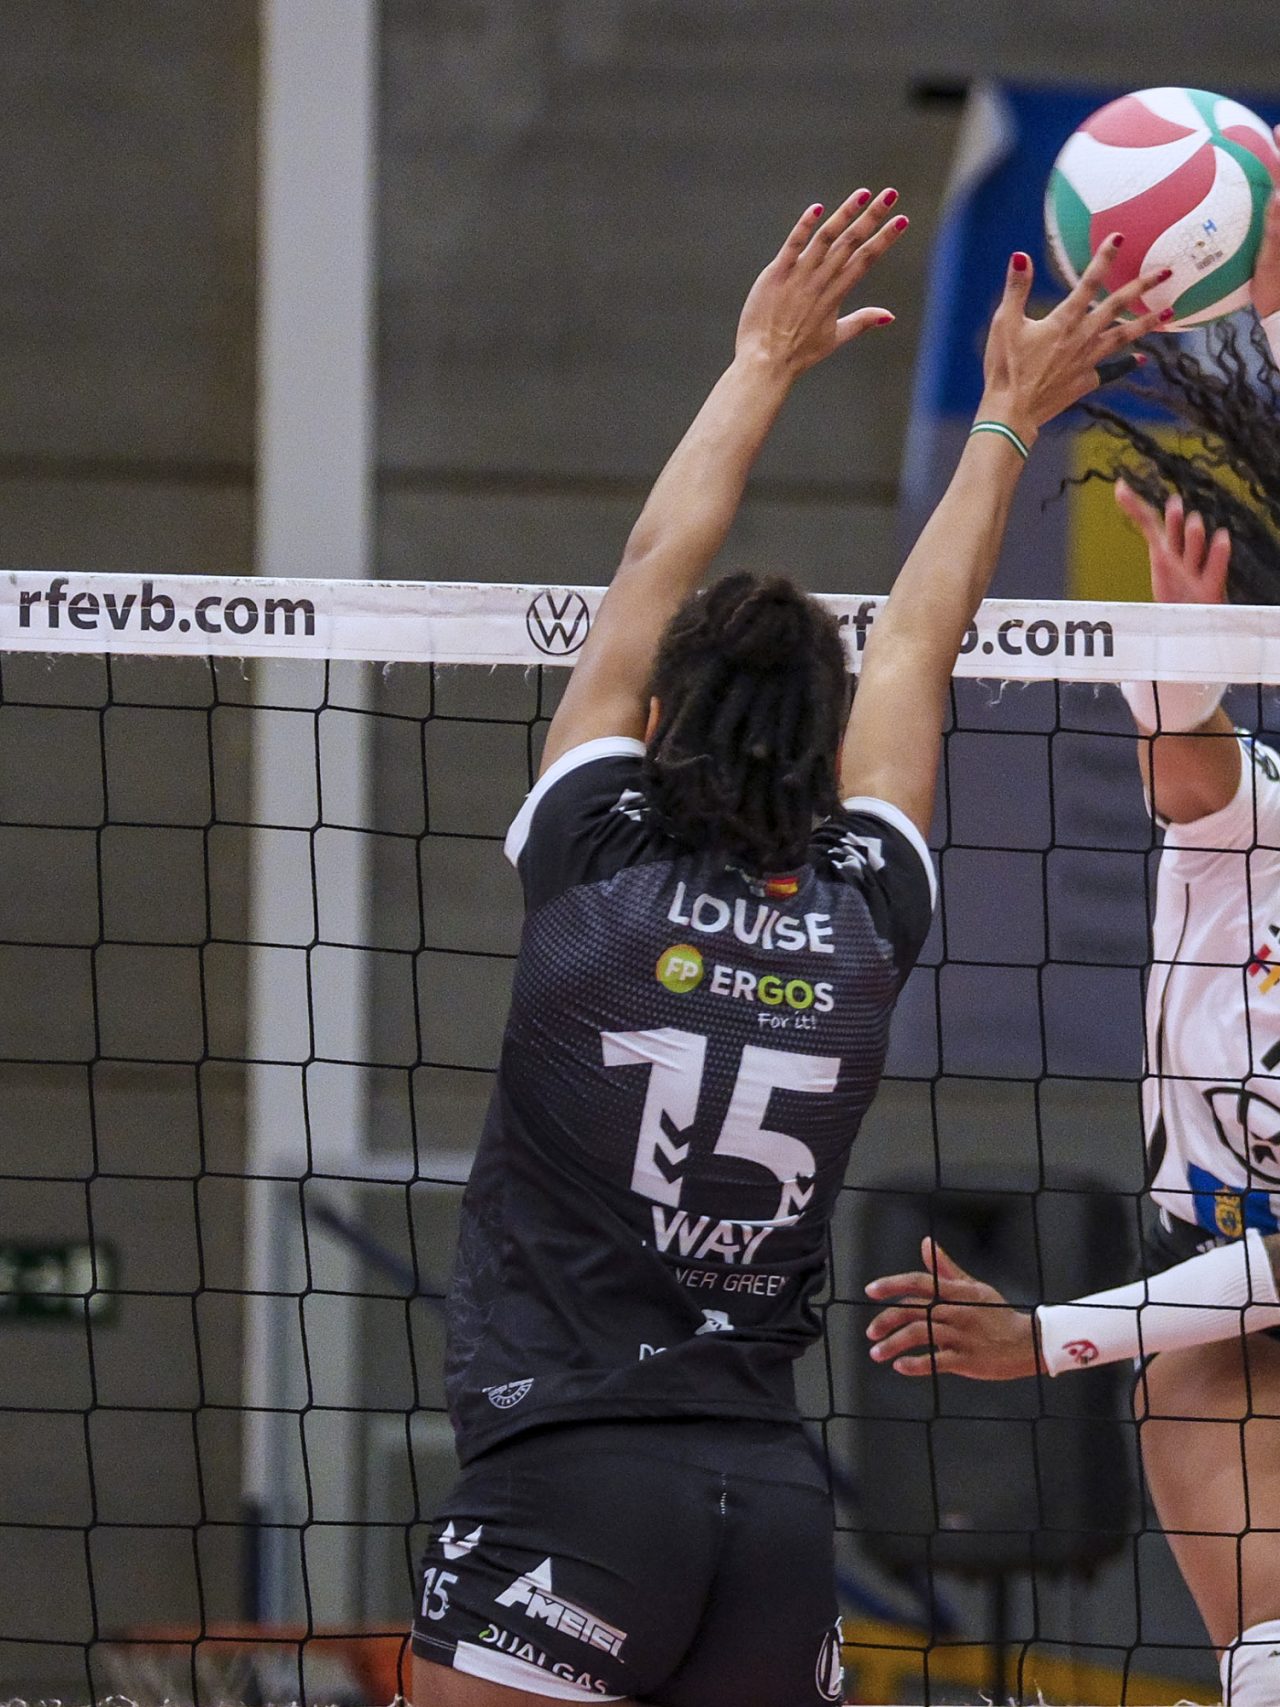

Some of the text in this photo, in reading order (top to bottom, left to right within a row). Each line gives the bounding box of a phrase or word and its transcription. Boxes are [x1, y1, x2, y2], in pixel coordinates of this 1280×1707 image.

[18, 578, 316, 636] rfevb.com
[667, 881, 835, 954] LOUISE
[664, 957, 835, 1012] FP ERGOS
[601, 1027, 842, 1228] 15
[650, 1205, 774, 1265] WAY
[421, 1567, 458, 1620] 15
